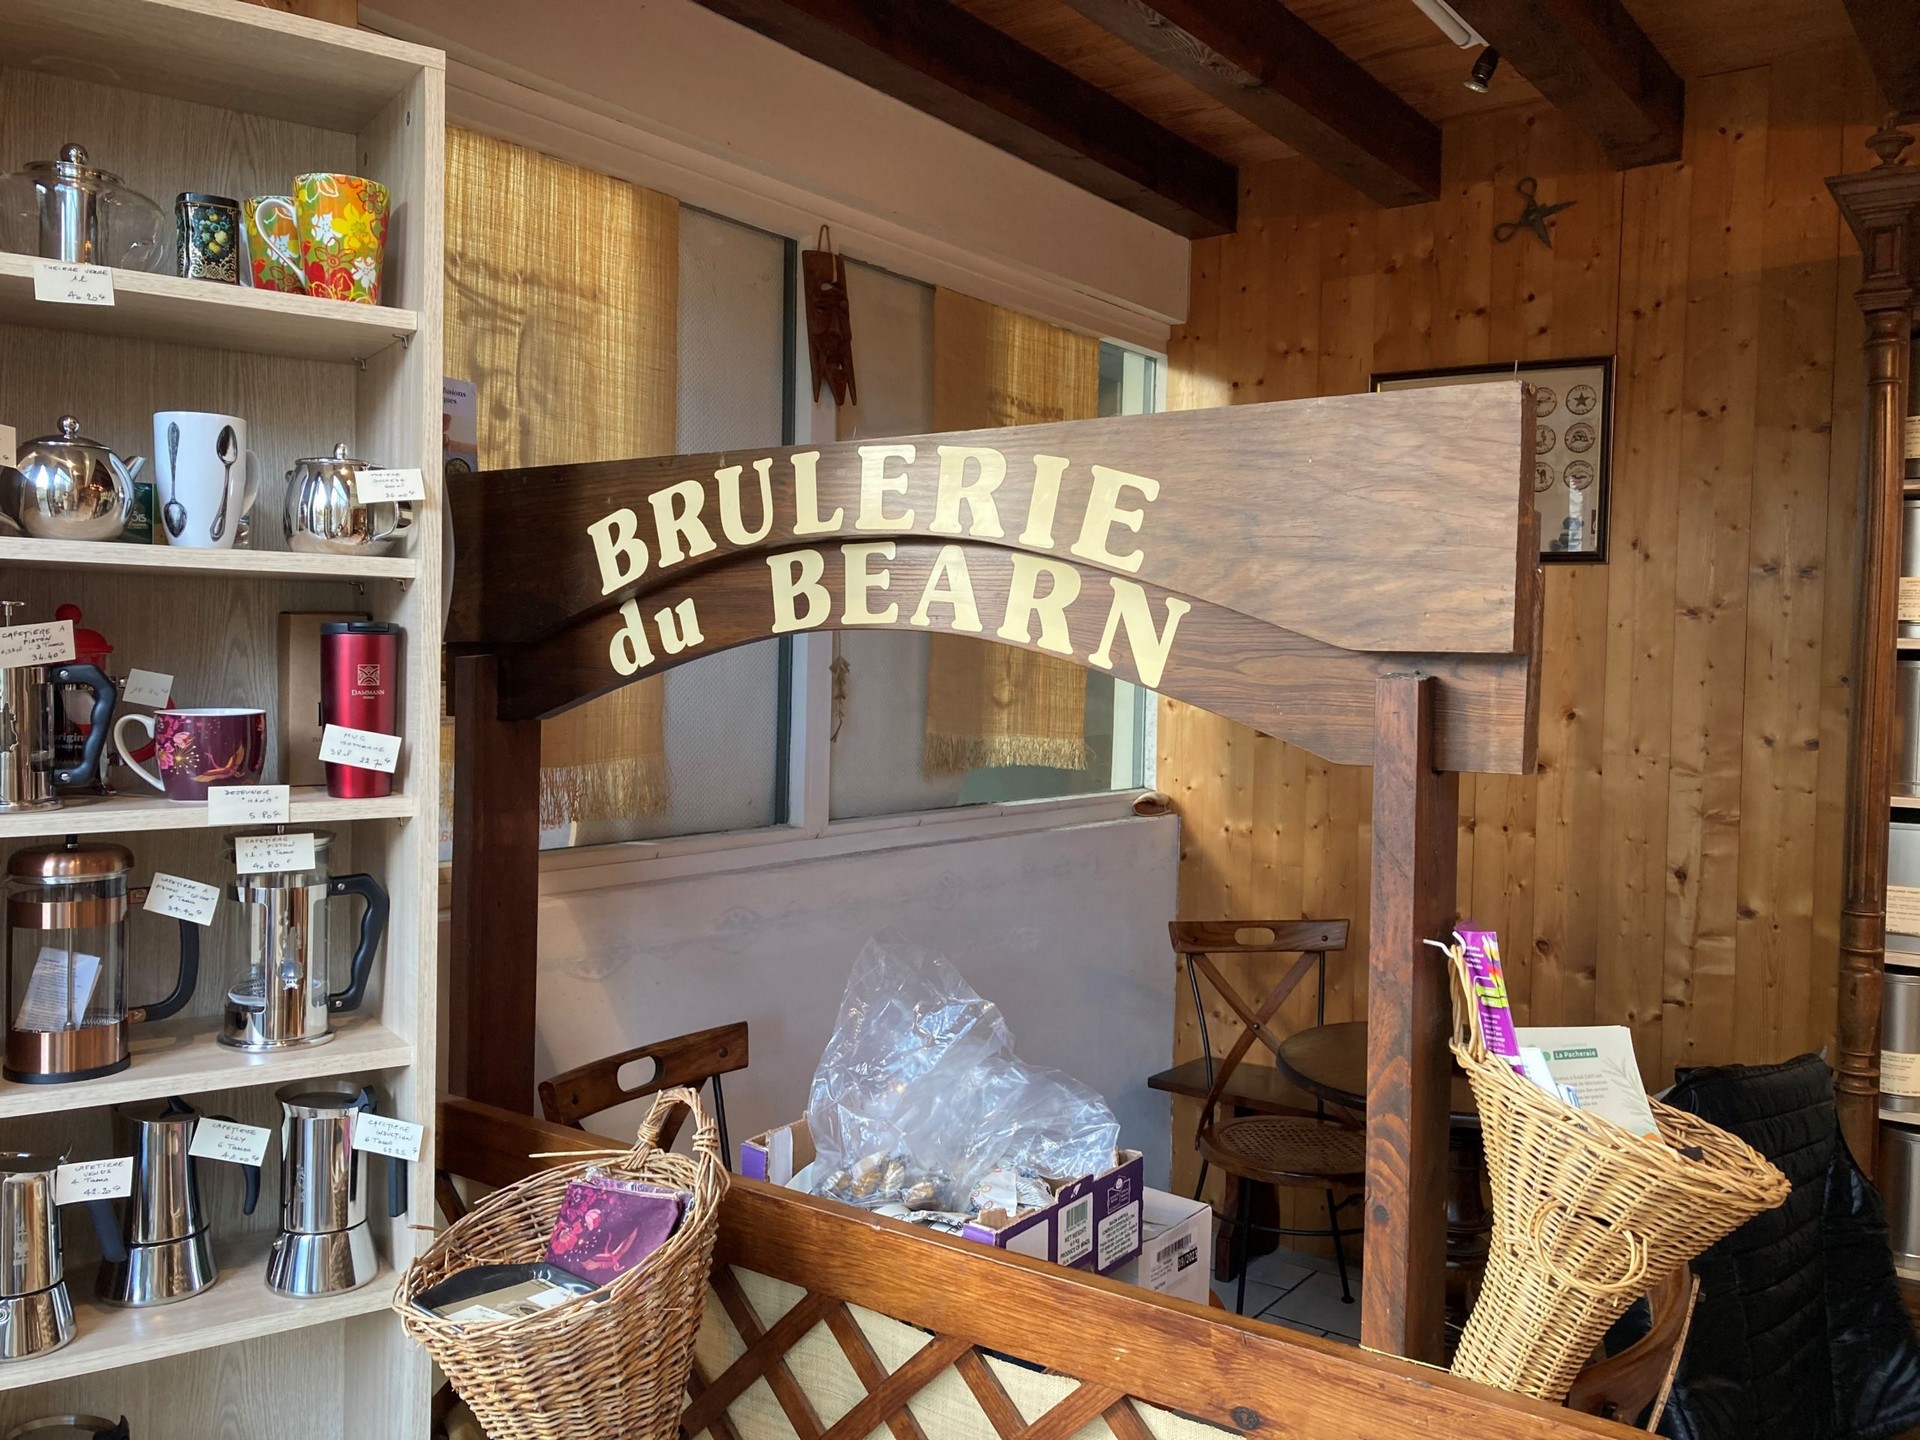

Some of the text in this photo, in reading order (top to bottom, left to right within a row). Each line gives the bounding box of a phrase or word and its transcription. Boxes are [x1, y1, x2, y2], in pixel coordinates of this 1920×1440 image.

[587, 444, 1161, 597] BRULERIE
[609, 541, 1191, 688] du BEARN
[1555, 1050, 1596, 1059] La Pacheraie
